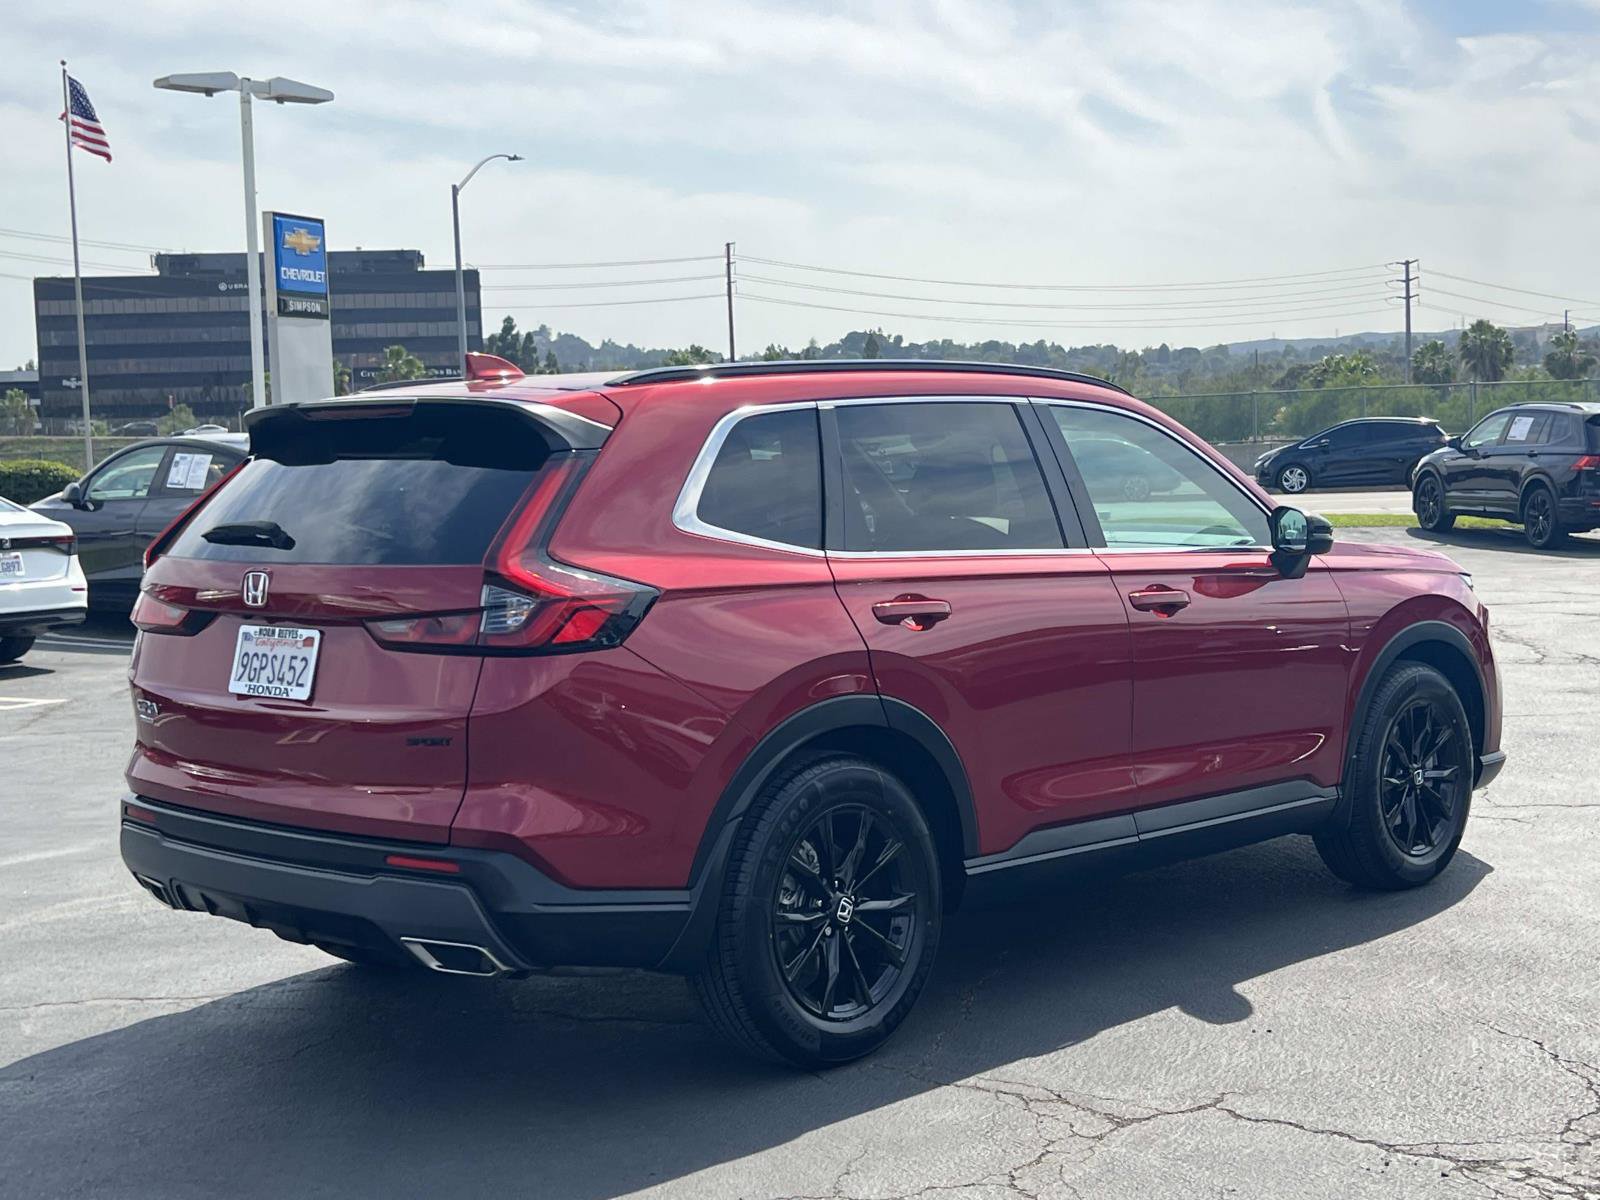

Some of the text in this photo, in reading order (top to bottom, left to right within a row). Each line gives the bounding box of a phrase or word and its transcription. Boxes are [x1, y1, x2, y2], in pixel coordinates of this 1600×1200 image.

[281, 266, 326, 283] CHEVROLET
[289, 301, 321, 313] SIMPSON
[258, 628, 276, 638] NORM
[278, 629, 299, 639] REEVES
[235, 652, 308, 687] 9GPS452
[246, 684, 290, 697] HONDA
